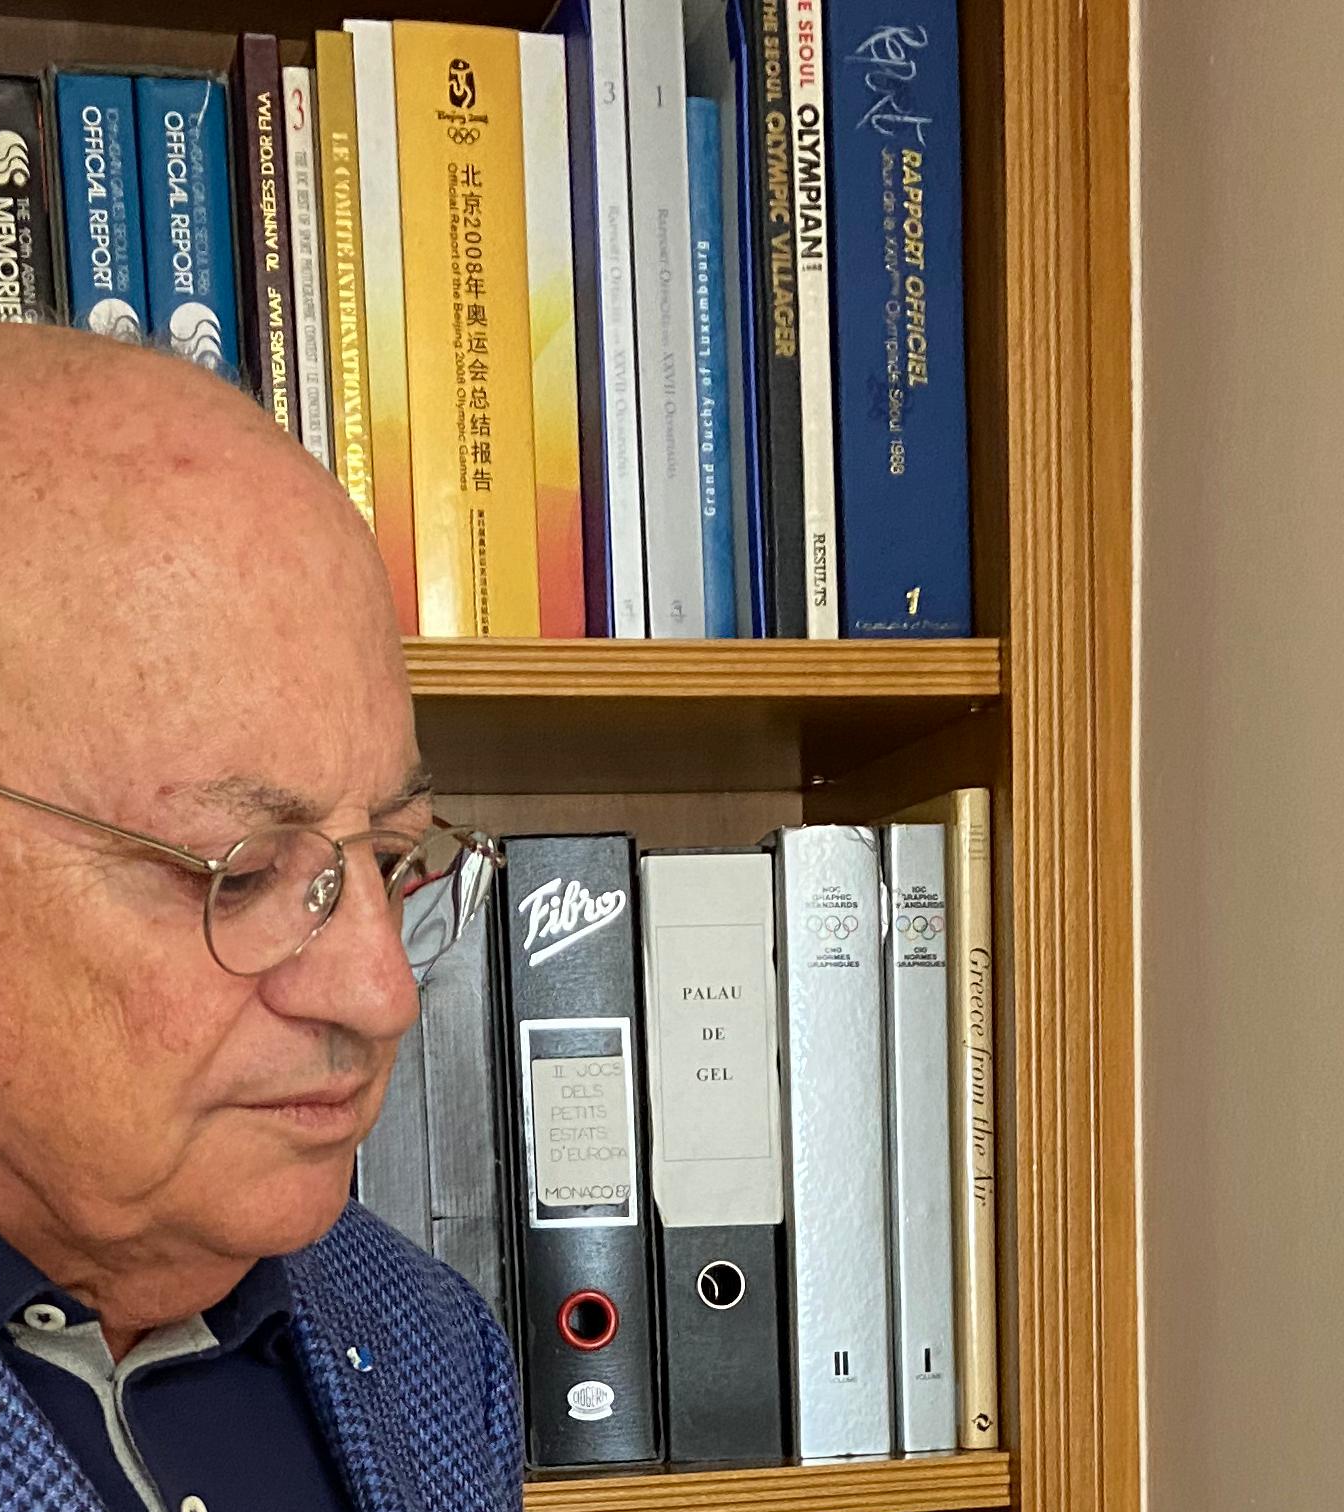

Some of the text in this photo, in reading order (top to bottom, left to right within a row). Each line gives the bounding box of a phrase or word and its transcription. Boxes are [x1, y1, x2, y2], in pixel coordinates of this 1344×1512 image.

[762, 35, 782, 101] SEOUL
[798, 19, 814, 87] SEOUL
[290, 89, 306, 131] 3
[603, 81, 616, 104] 3
[80, 105, 112, 291] OFFICIAL REPORT
[162, 110, 194, 294] OFFICIAL REPORT
[764, 110, 790, 223] OLYMPIC
[795, 102, 824, 258] OLYMPIAN
[13, 196, 40, 304] THE ASIAN
[255, 91, 286, 384] YEARS IAAF 70 ANNÉES D'OR FIAA
[899, 147, 927, 388] RAPPORT OFFICIEL
[329, 130, 367, 439] LE INTERNATIONAL
[768, 230, 796, 358] VILLAGER
[446, 162, 471, 491] Official Report of the Beijing 2008 Olympic Games
[456, 162, 496, 492] 北京2008年奥运会总结报告
[693, 240, 717, 516] Grand Duchy of Luxembourg
[889, 439, 904, 475] 1988
[810, 533, 828, 606] RESULTS
[906, 586, 921, 615] 1
[518, 877, 627, 966] Fibro
[682, 985, 743, 1001] PALAU
[575, 1063, 625, 1079] JOCS
[702, 1027, 726, 1042] DE
[561, 1085, 605, 1099] DELS
[696, 1067, 734, 1082] GEL
[963, 947, 993, 1206] Greece from the Air
[550, 1127, 608, 1143] ESTATS
[551, 1105, 608, 1121] PETITS
[550, 1146, 628, 1163] D'EUROPA
